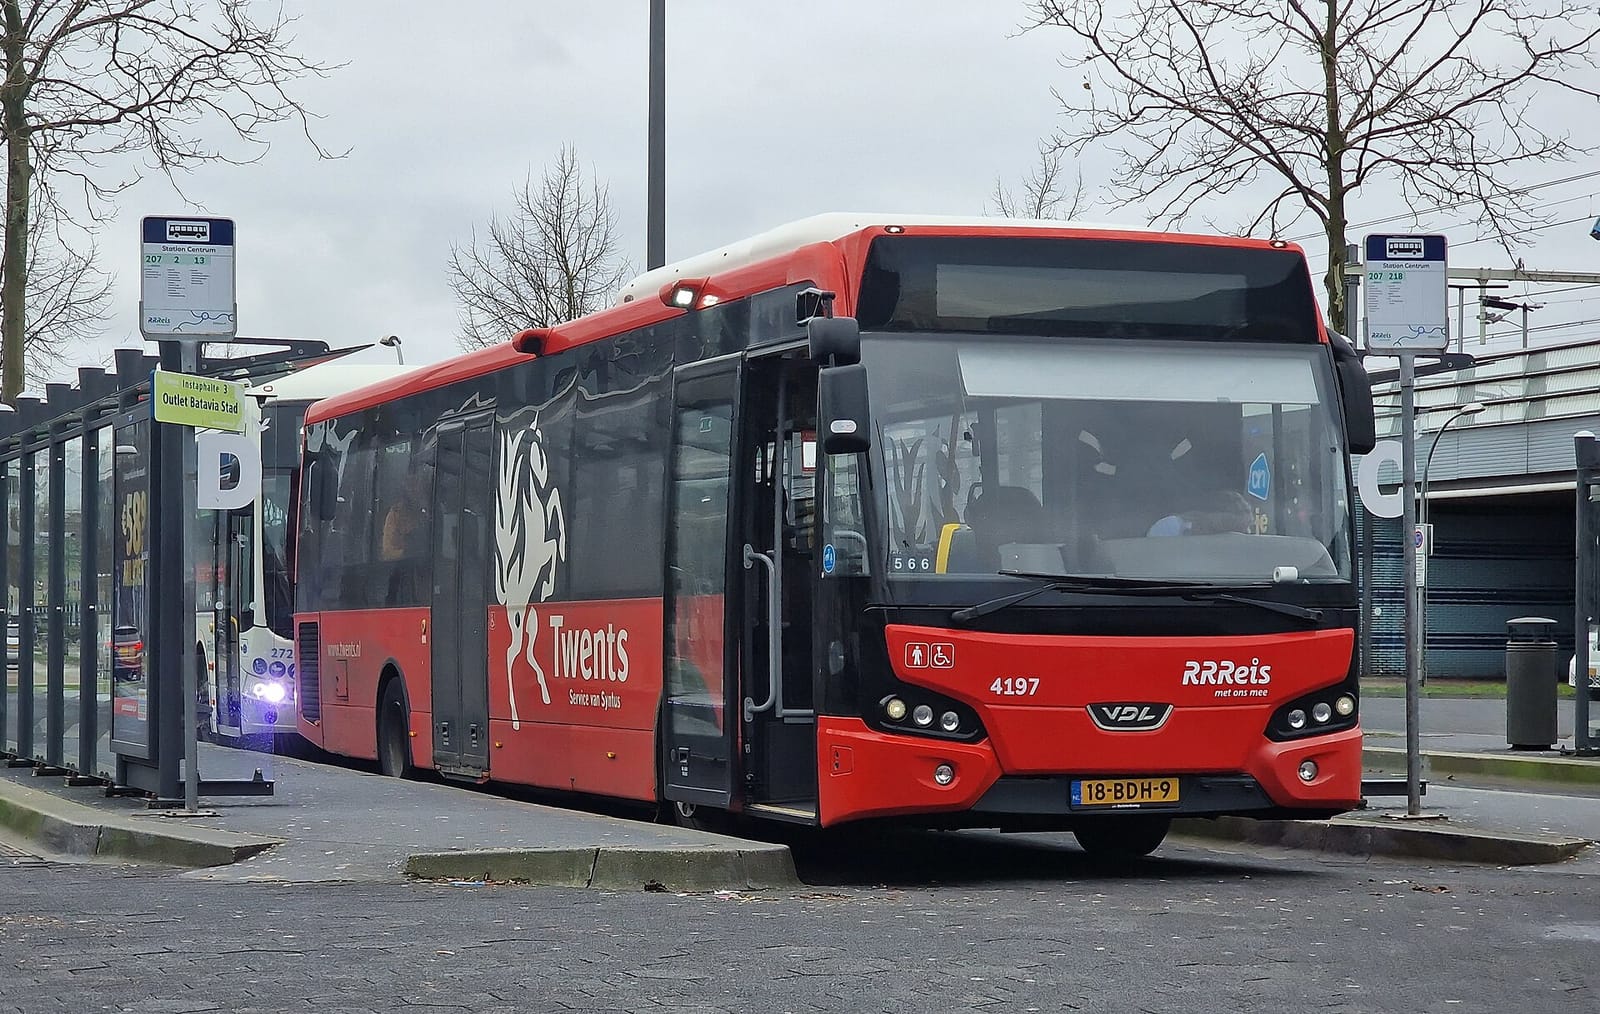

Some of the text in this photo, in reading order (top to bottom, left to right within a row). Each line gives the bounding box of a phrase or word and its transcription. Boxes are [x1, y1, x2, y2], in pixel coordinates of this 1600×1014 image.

[145, 255, 205, 265] 207 2 13
[1368, 272, 1403, 280] 207 218
[182, 379, 229, 394] Instaphalte 3
[162, 392, 239, 414] Outlet Batavia Stad
[198, 434, 262, 509] D
[1357, 440, 1405, 519] C
[271, 648, 294, 659] 272
[549, 615, 629, 683] Twents
[1182, 657, 1272, 685] RRReis
[990, 677, 1041, 696] 4197
[1214, 689, 1268, 697] met ons mee
[569, 688, 621, 711] Service van Syntus
[1102, 706, 1156, 722] VDL
[1086, 781, 1171, 801] 18-BDH-9
